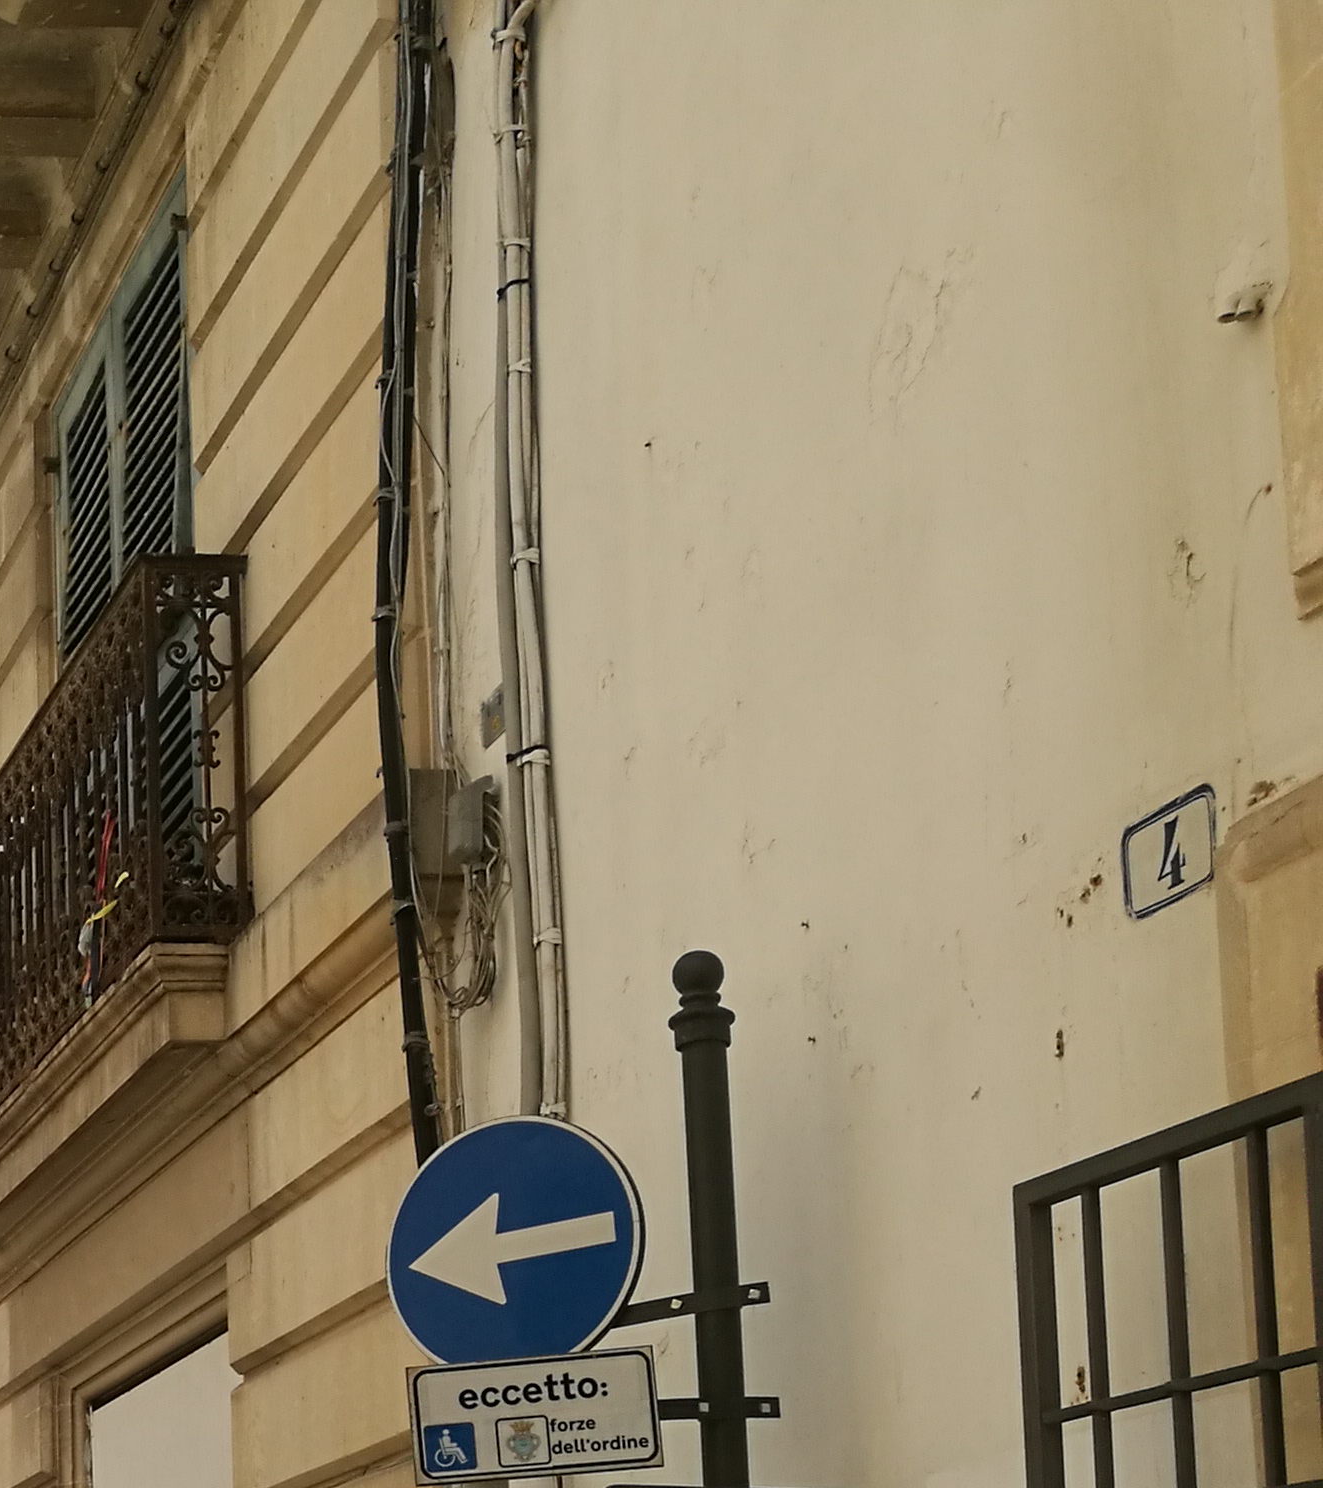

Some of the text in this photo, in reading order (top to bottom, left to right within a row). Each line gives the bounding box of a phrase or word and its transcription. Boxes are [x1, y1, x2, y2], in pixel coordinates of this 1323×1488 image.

[1158, 815, 1186, 890] 4
[458, 1372, 609, 1410] eccetto:
[549, 1417, 597, 1433] forze
[551, 1434, 650, 1456] dell'ordine
